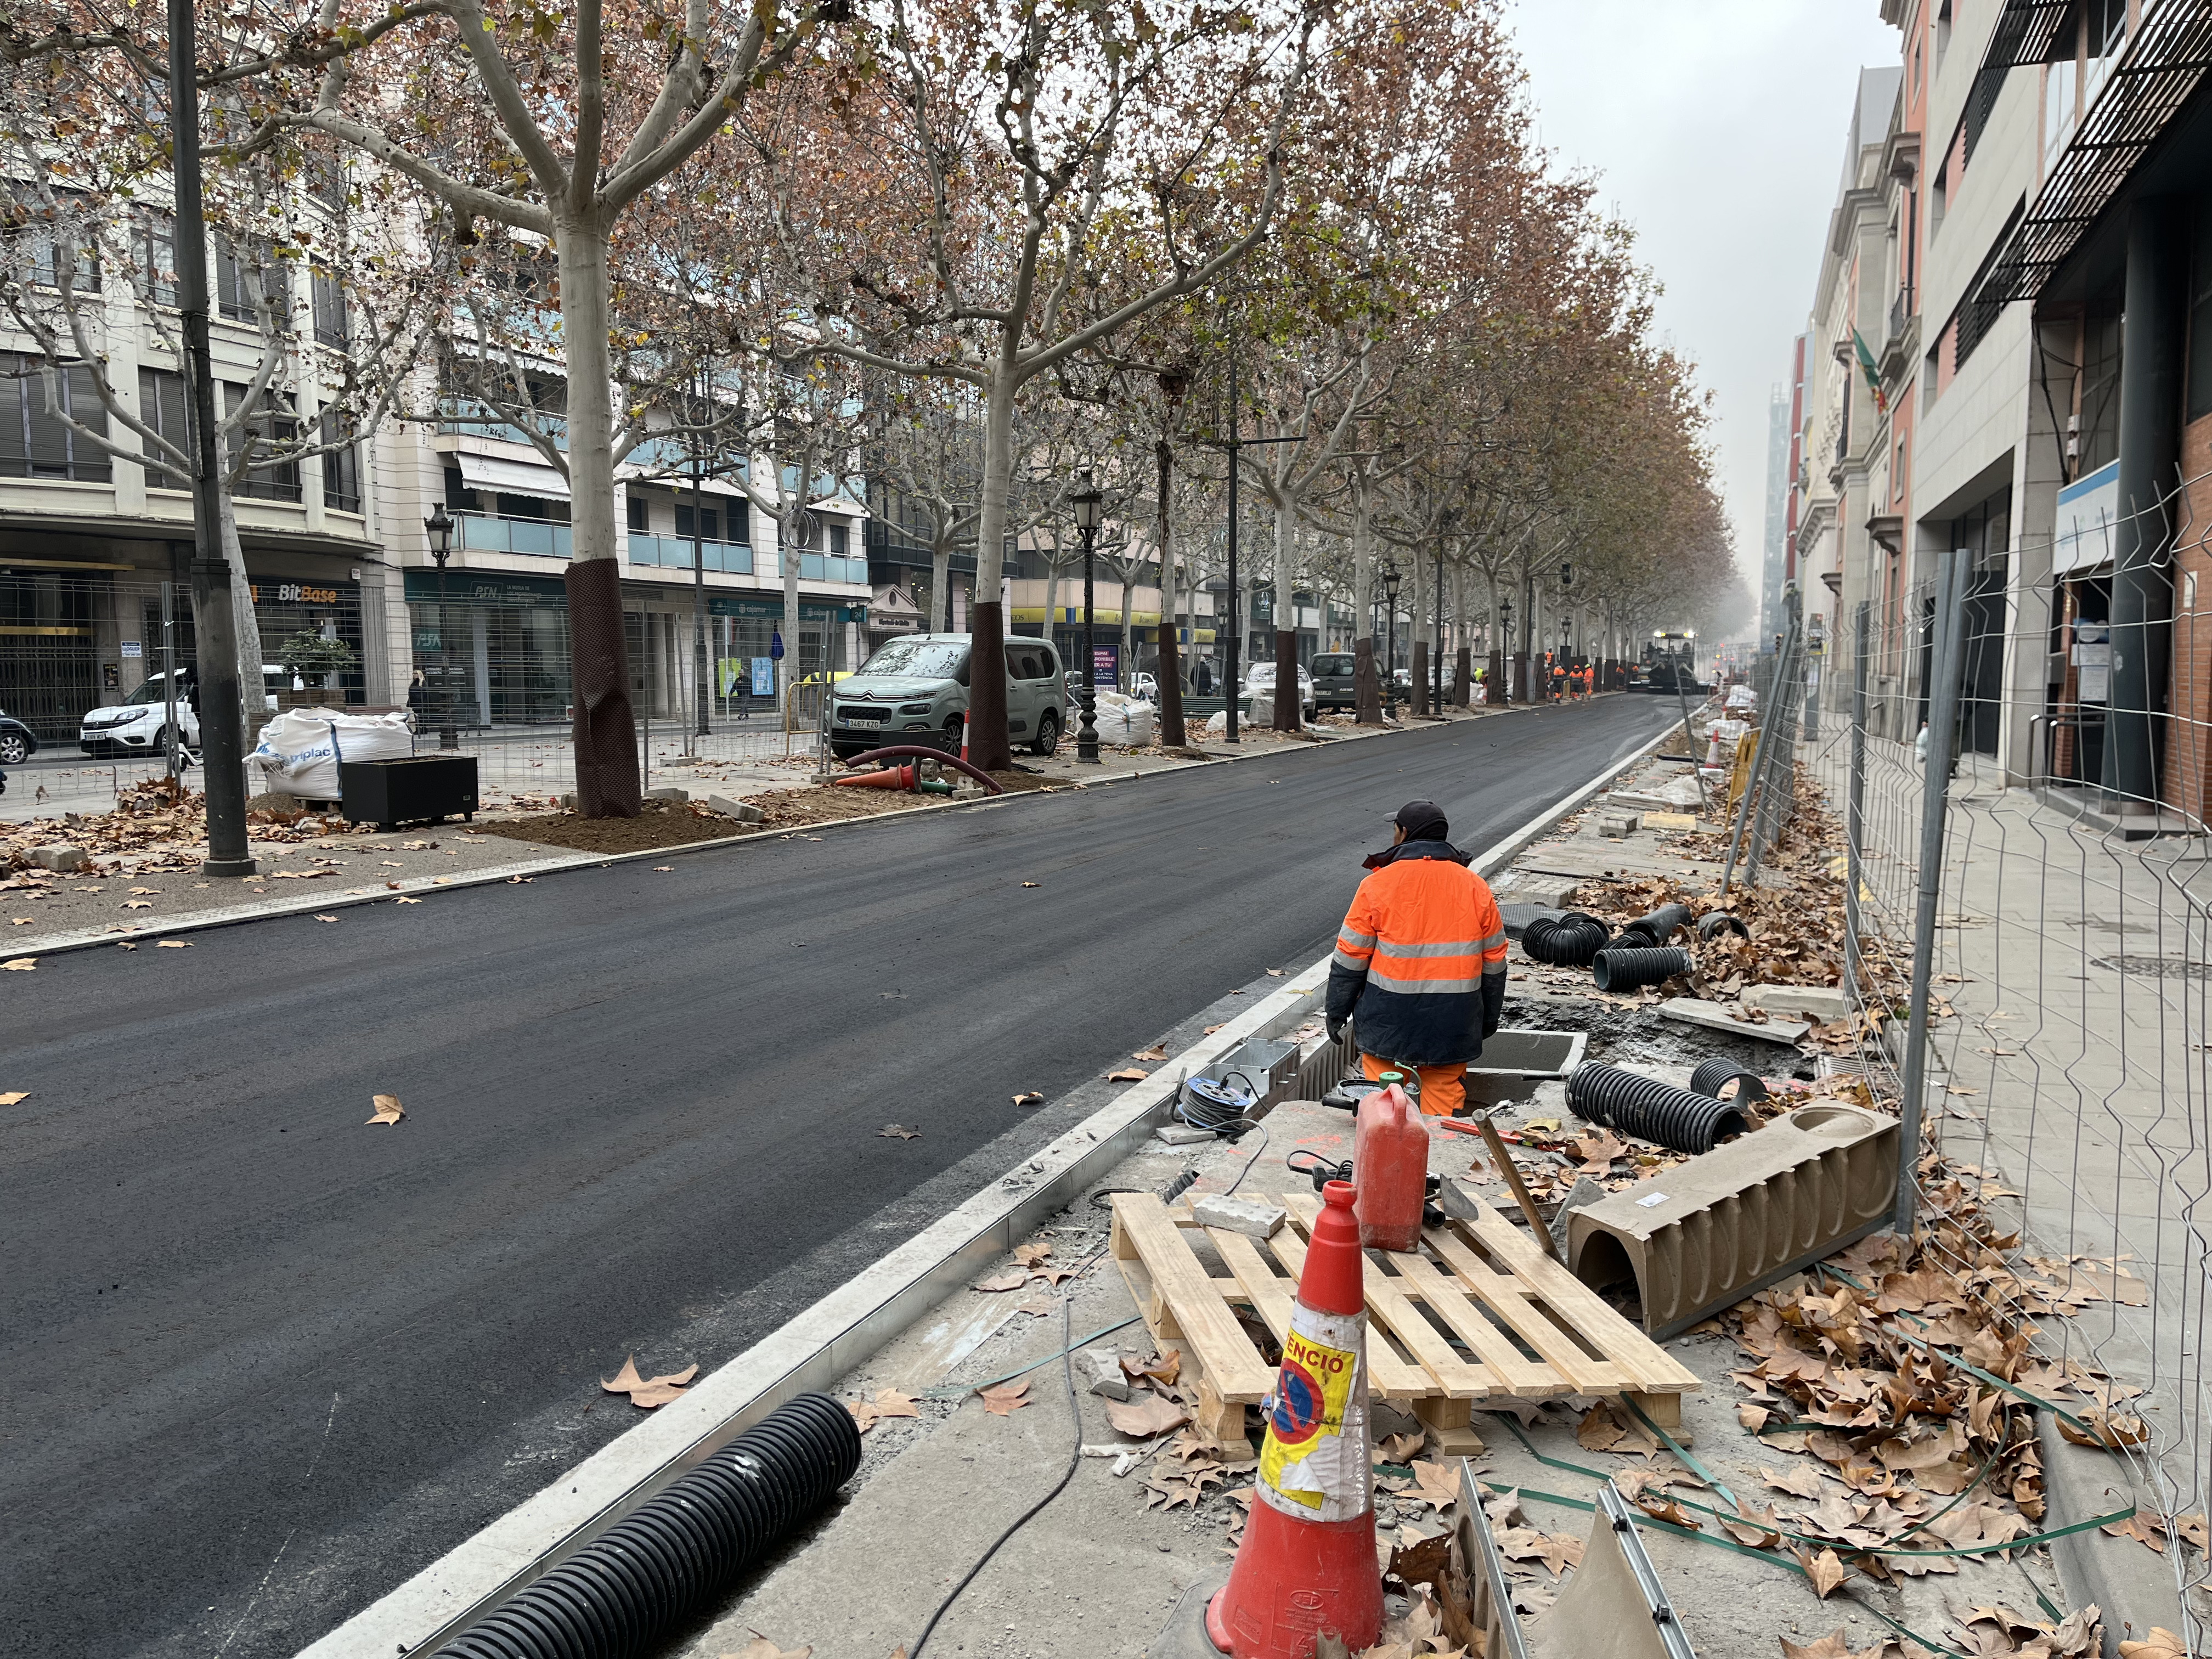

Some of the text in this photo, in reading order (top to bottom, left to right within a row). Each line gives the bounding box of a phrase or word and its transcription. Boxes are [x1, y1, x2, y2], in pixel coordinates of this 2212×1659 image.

[278, 584, 337, 603] BitBase
[475, 586, 497, 597] PSN
[1287, 1335, 1344, 1374] ENCIÓ
